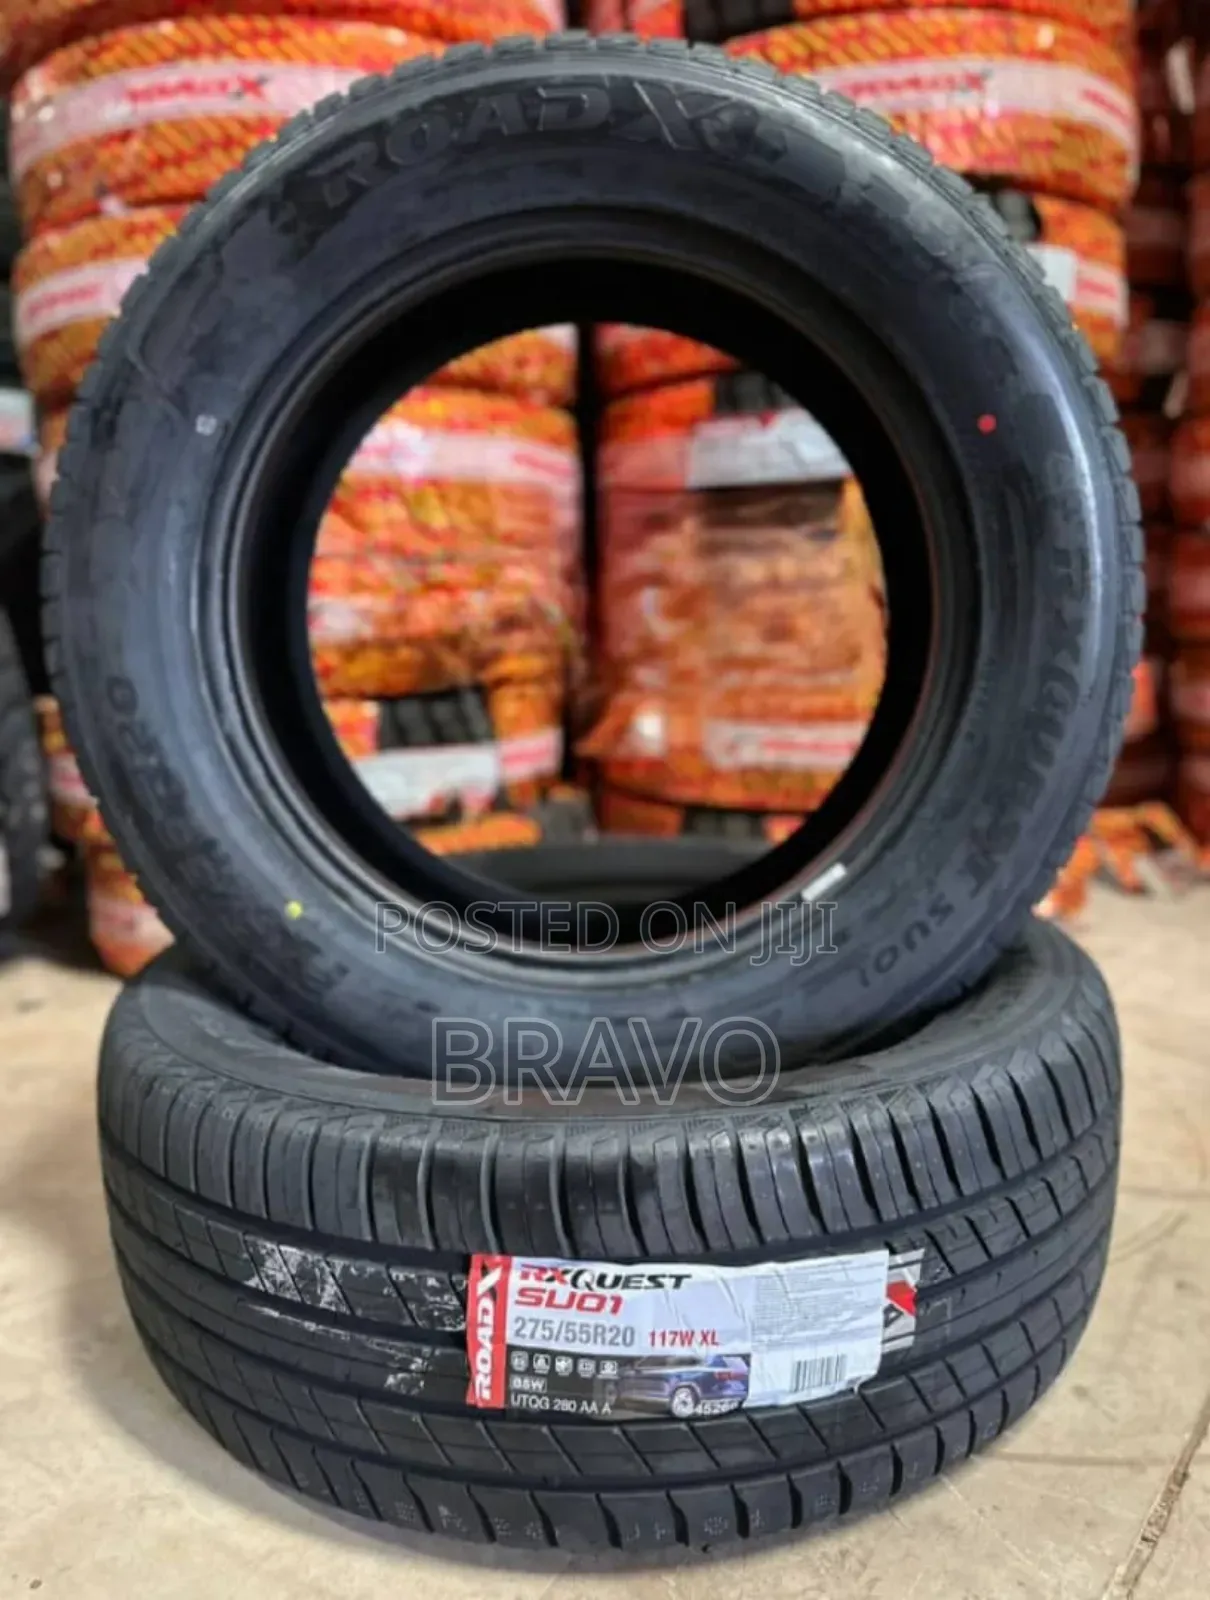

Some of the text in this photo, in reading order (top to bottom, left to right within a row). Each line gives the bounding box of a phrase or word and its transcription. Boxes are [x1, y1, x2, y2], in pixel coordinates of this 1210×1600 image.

[518, 1263, 692, 1292] RXQUEST
[474, 1259, 503, 1401] ROADX
[513, 1316, 720, 1347] 275/55R20 117W XL
[601, 1401, 612, 1416] A
